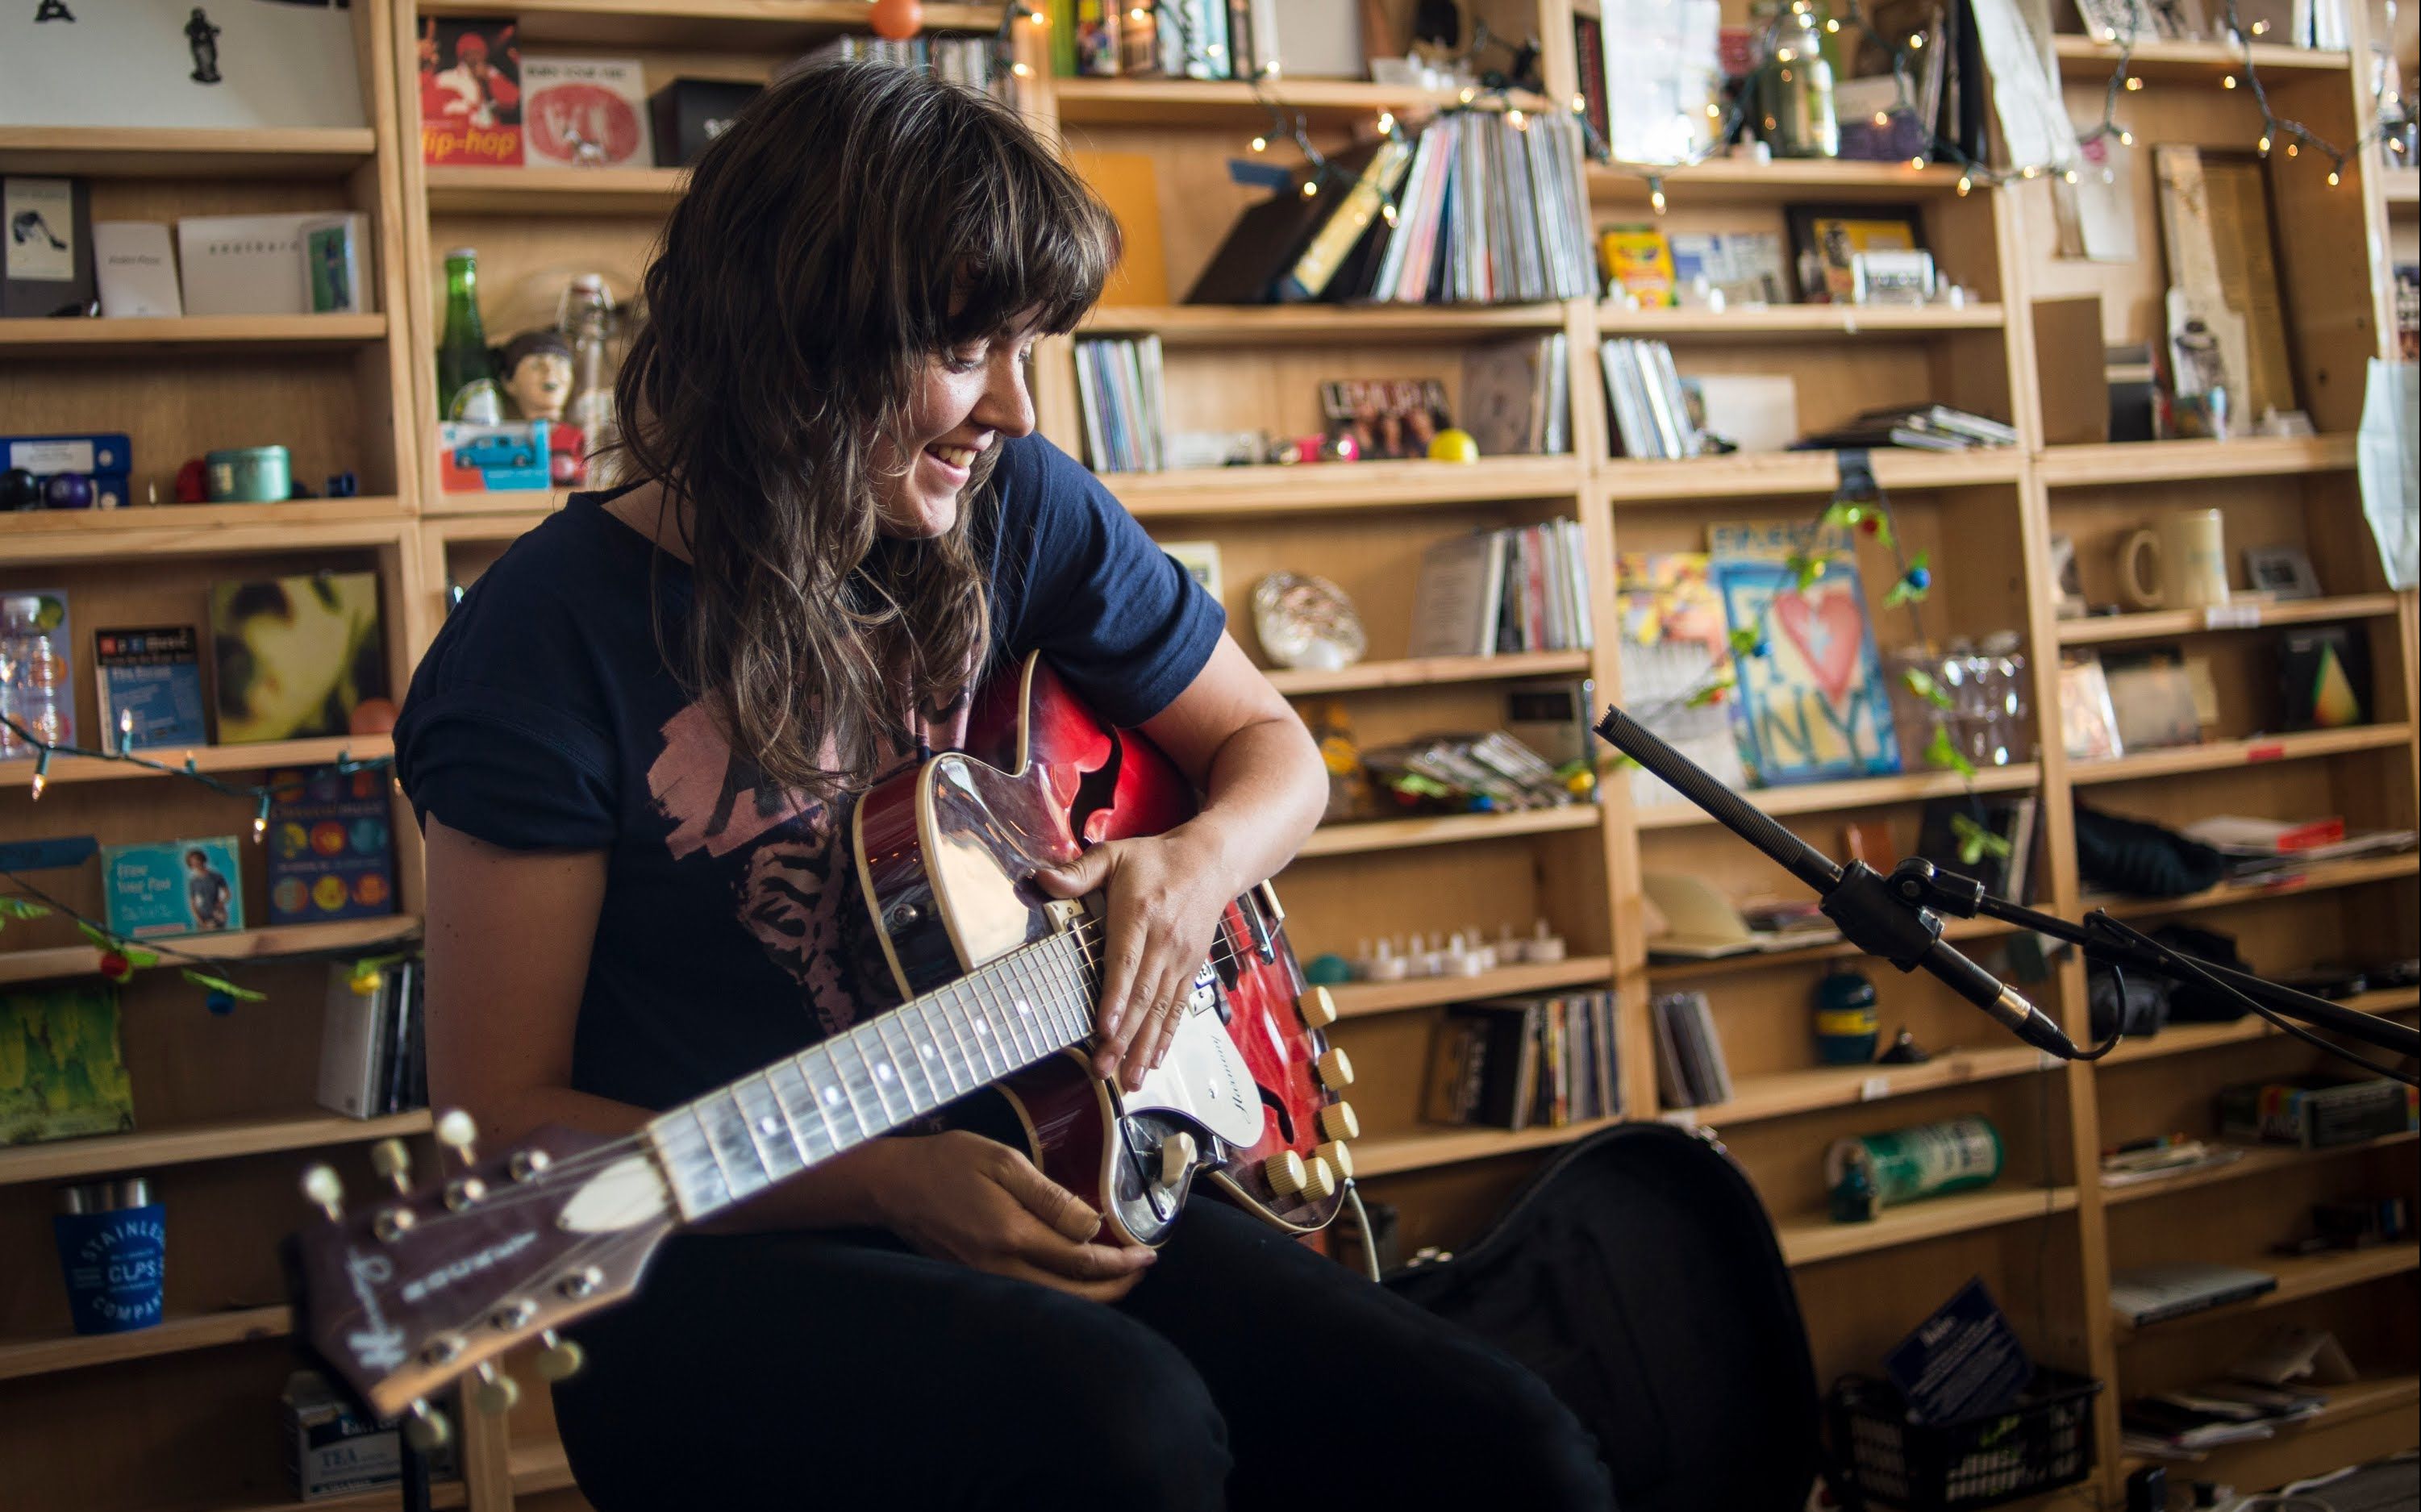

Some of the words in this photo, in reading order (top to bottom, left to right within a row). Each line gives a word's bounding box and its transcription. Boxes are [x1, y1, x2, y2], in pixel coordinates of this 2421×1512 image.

[1211, 1035, 1252, 1125] Harmony
[81, 1220, 166, 1264] STAINLE
[108, 1259, 156, 1283] CUPS
